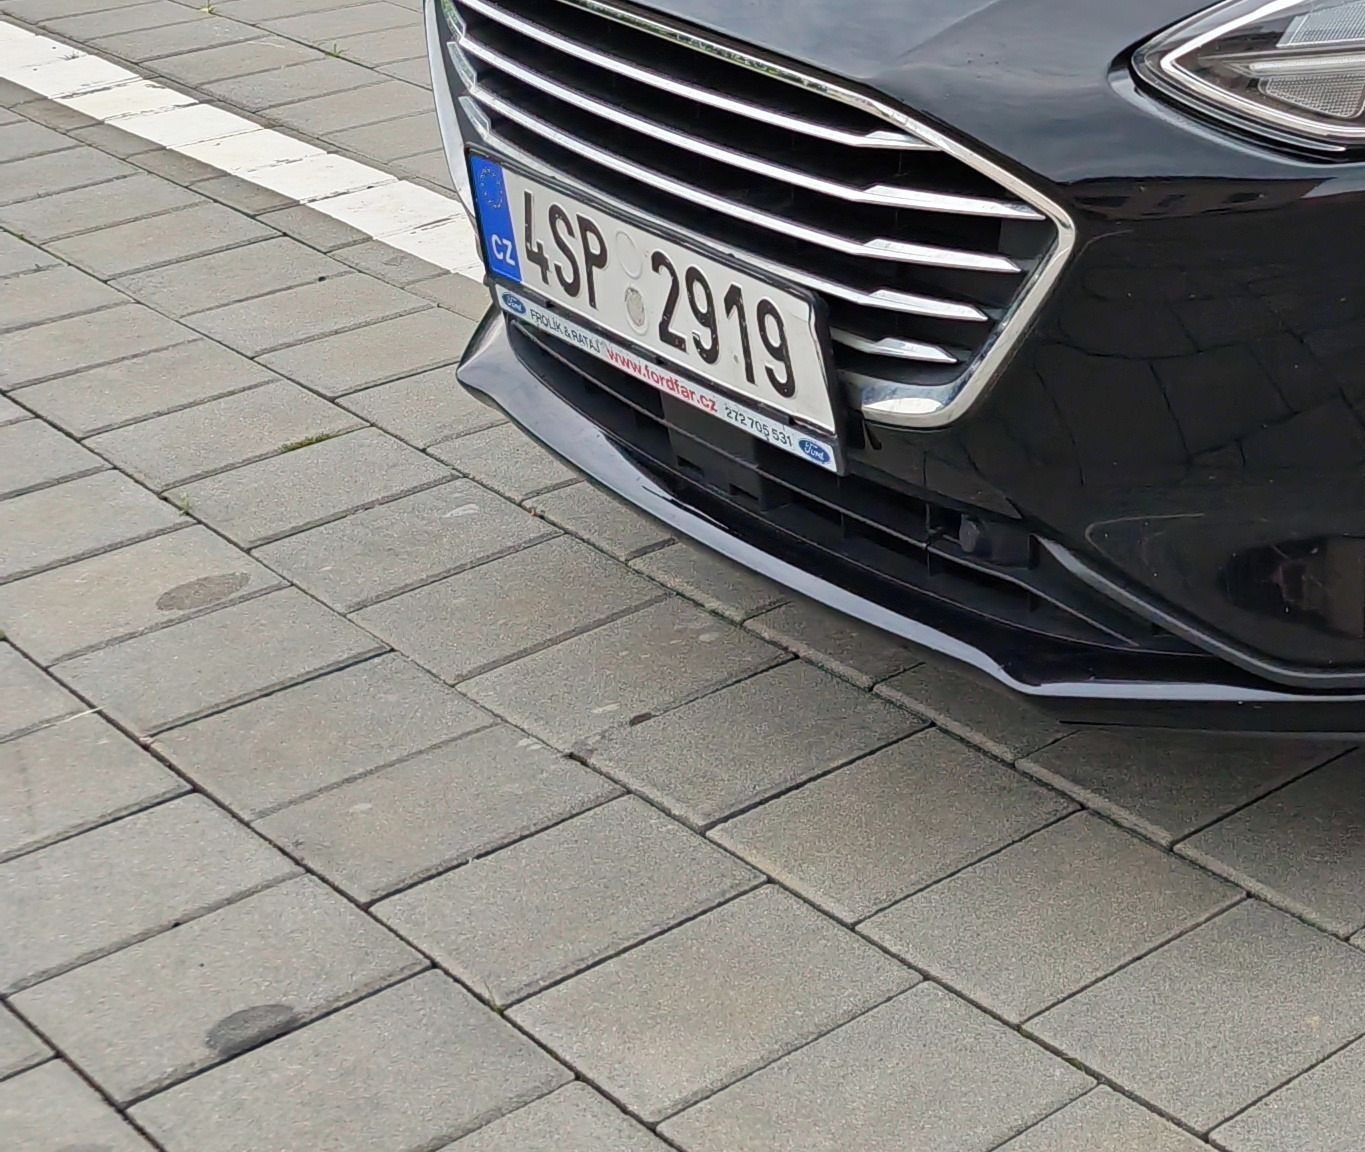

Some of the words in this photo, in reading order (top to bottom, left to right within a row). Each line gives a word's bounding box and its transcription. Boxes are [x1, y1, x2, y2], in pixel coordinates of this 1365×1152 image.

[491, 234, 515, 266] CZ
[523, 190, 608, 310] 4SP
[651, 250, 797, 398] 2919
[606, 347, 718, 412] www.fordfar.cz
